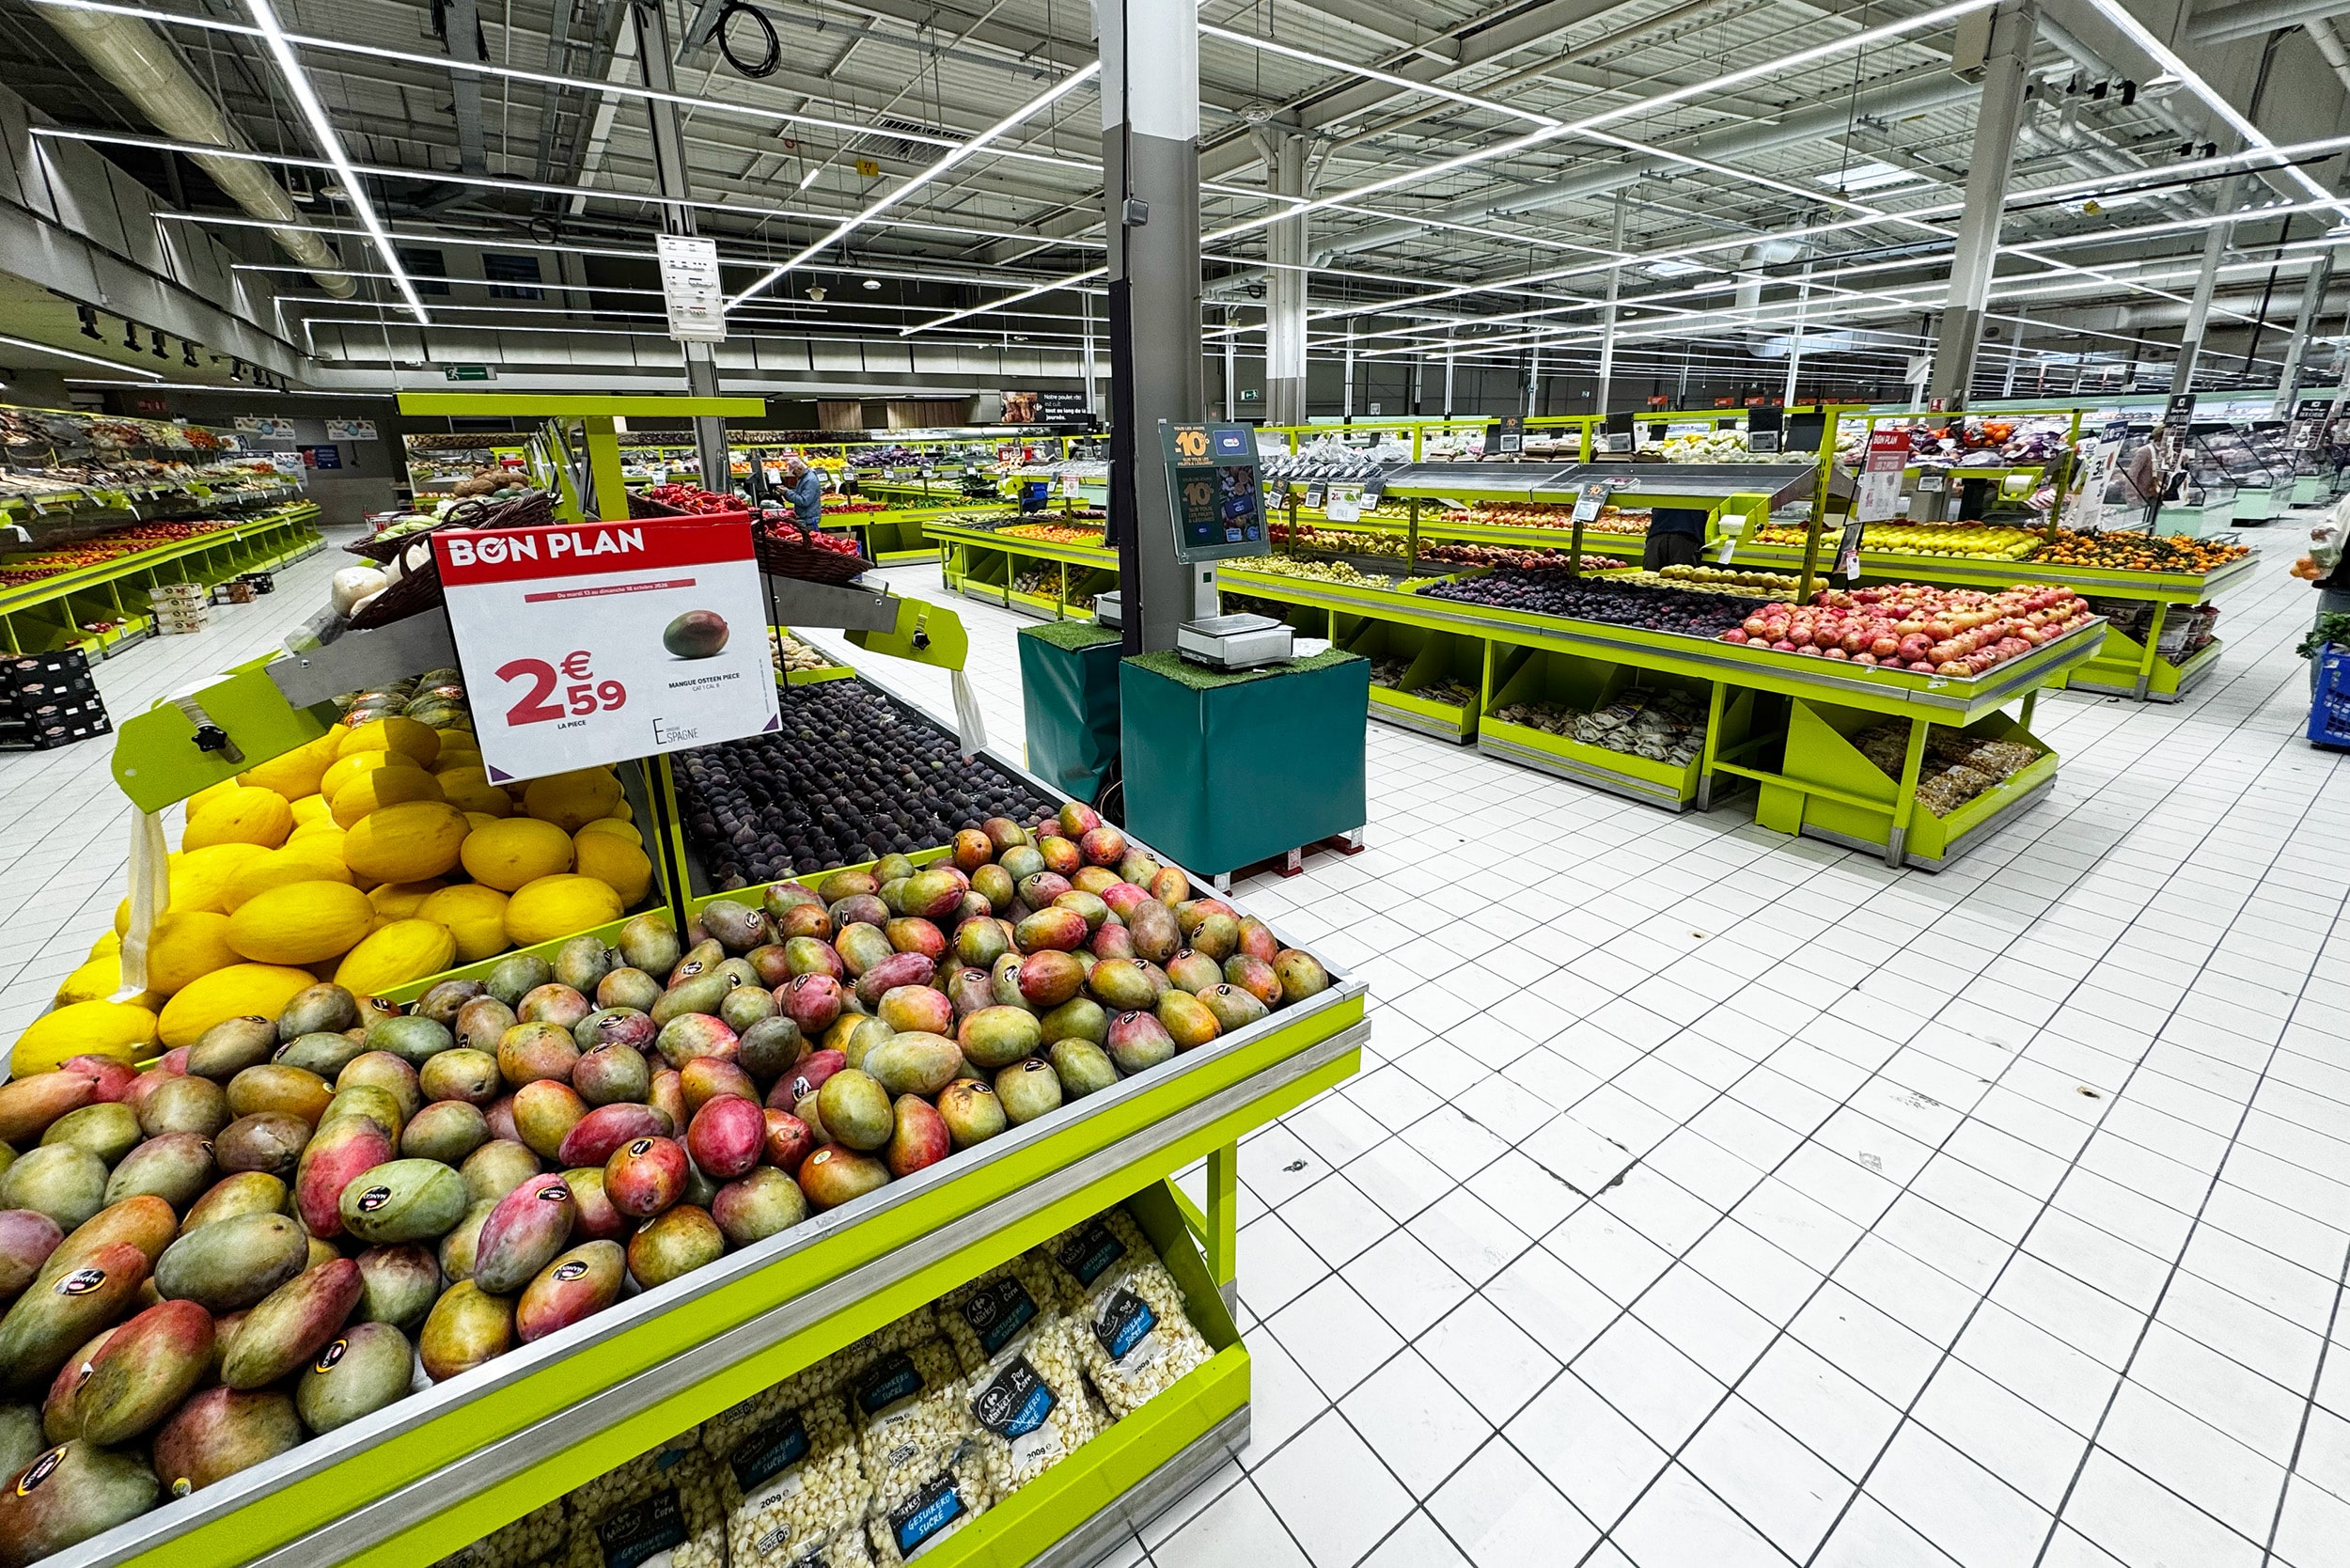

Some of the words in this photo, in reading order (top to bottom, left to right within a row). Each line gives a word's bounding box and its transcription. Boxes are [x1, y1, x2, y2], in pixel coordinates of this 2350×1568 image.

[1885, 436, 1898, 445] PLAN
[447, 535, 539, 566] BON
[547, 527, 645, 559] PLAN
[599, 587, 626, 595] dimanche
[669, 679, 697, 688] MANGUE
[697, 675, 722, 684] OSTEEN
[723, 672, 740, 681] PIECE
[568, 719, 587, 728] PIECE
[1003, 1287, 1018, 1302] Corn
[972, 1301, 997, 1324] Market
[1011, 1367, 1025, 1381] Pop
[1133, 1359, 1150, 1375] 200g
[1017, 1374, 1033, 1392] Corn
[986, 1393, 1015, 1426] Market
[884, 1415, 904, 1425] 200g
[1026, 1447, 1046, 1462] 200g
[930, 1476, 949, 1491] Corn
[760, 1494, 782, 1509] 200g
[655, 1505, 674, 1519] Corn
[606, 1515, 641, 1542] Market
[919, 1508, 944, 1535] SUCRÉ
